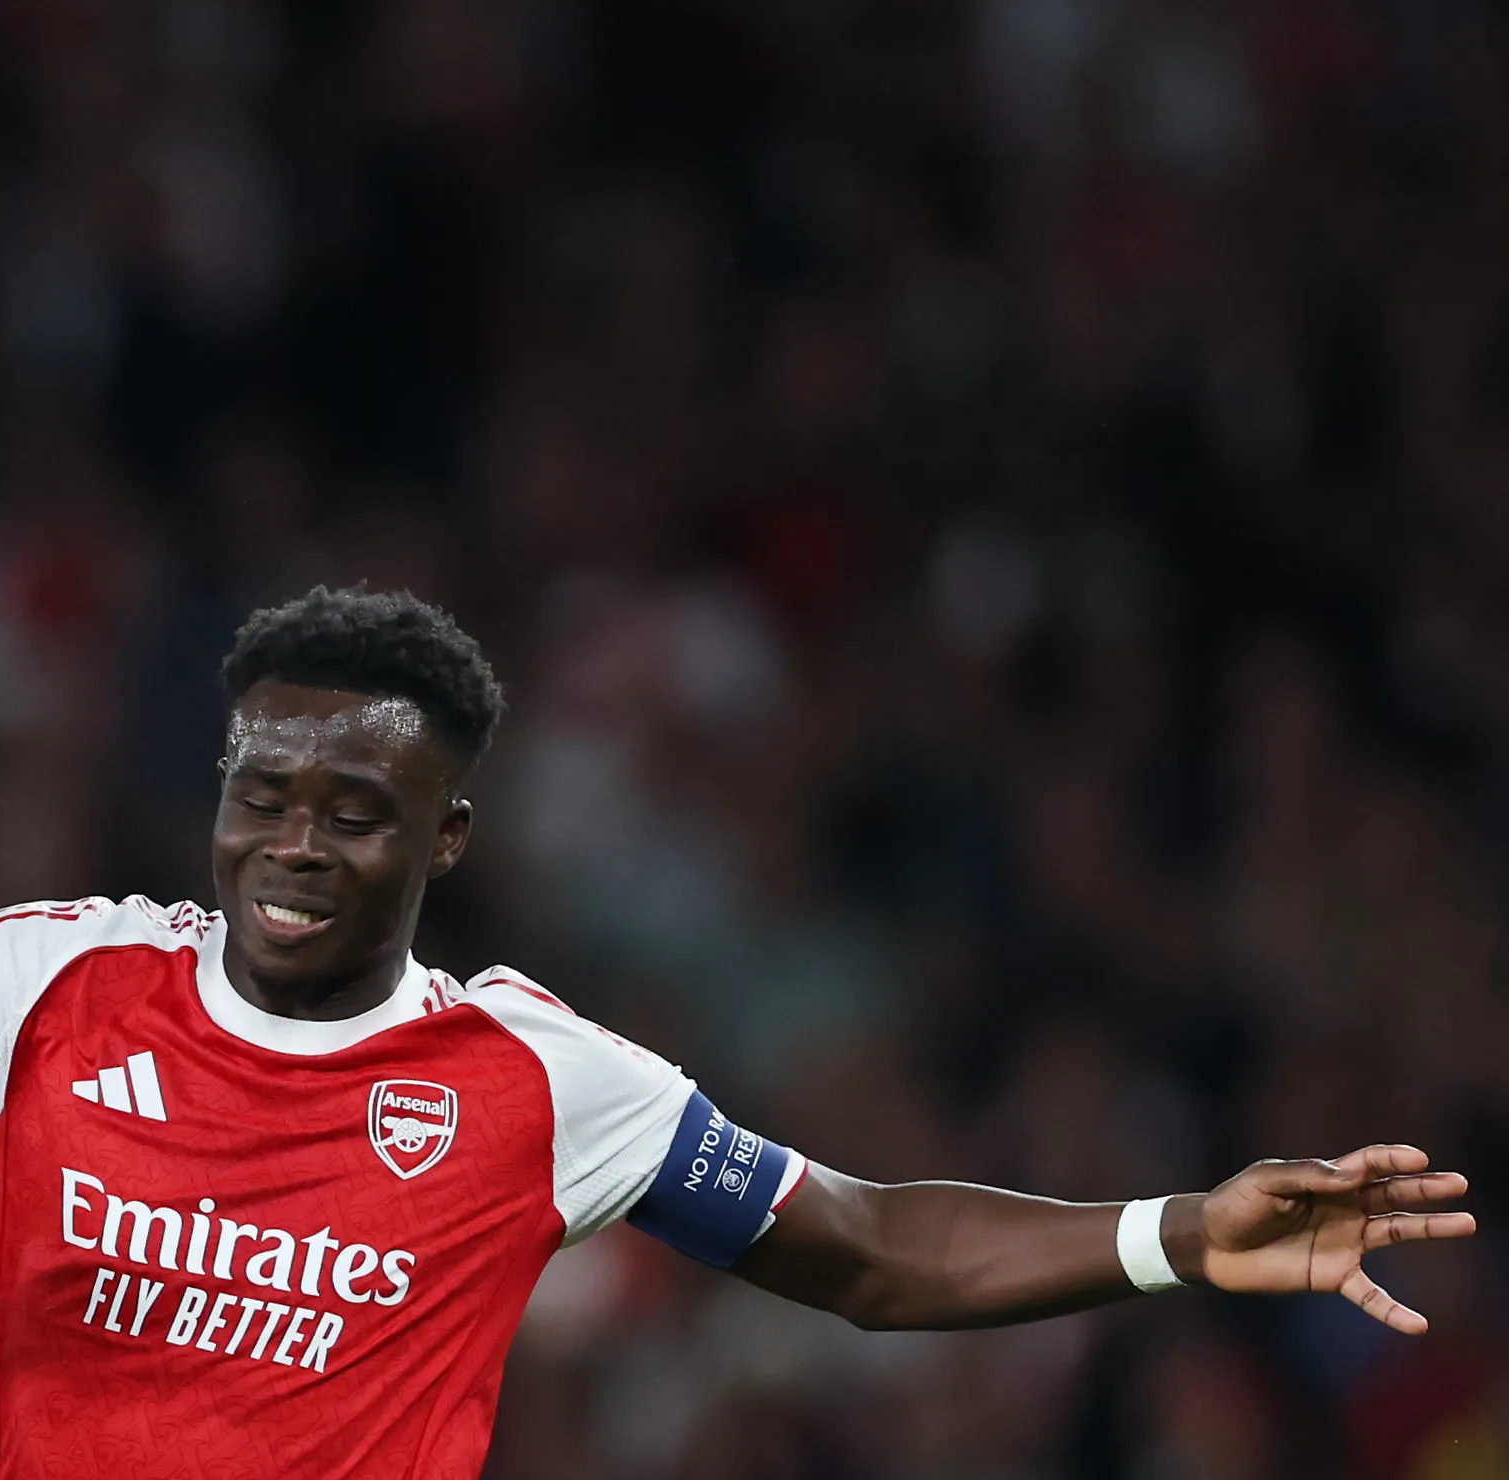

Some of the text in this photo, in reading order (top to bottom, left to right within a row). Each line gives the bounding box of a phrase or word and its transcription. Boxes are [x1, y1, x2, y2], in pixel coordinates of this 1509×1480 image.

[382, 1091, 446, 1117] Arsenal
[682, 1157, 709, 1192] NO
[698, 1130, 720, 1154] TO
[61, 1167, 416, 1307] Emirates
[83, 1267, 344, 1374] FLY BETTER
